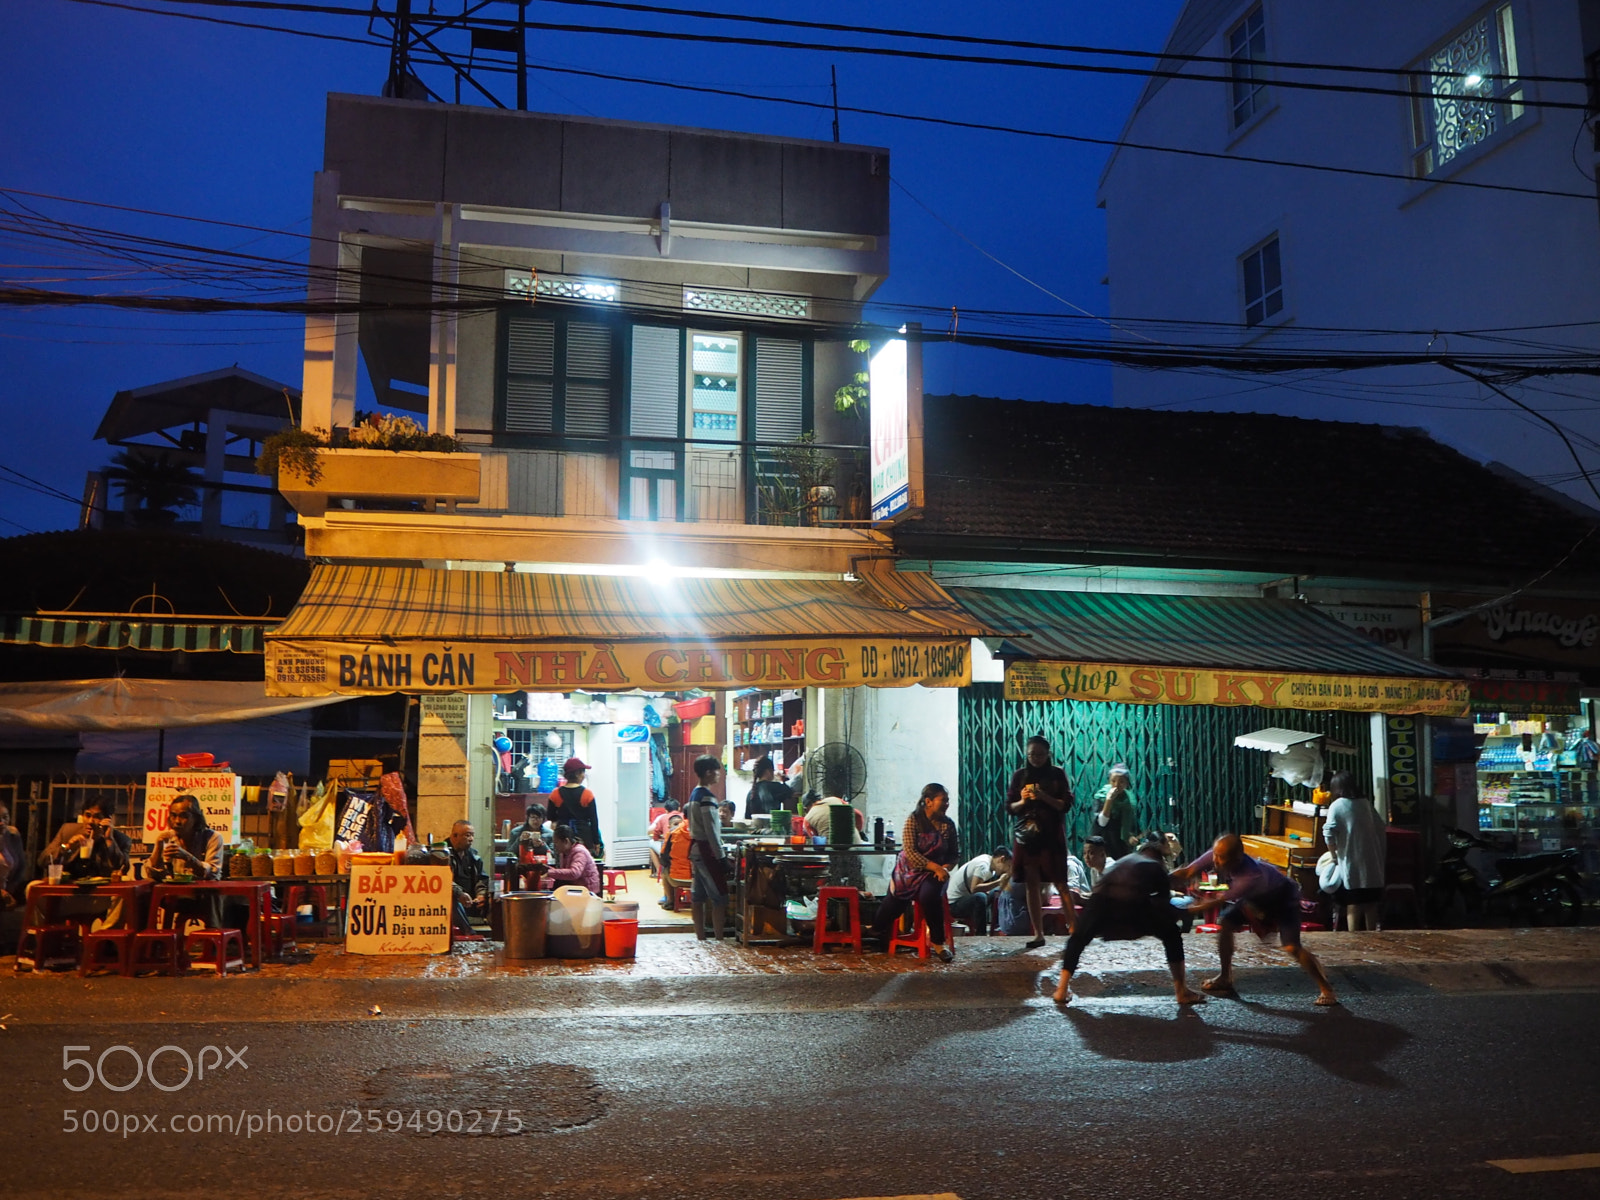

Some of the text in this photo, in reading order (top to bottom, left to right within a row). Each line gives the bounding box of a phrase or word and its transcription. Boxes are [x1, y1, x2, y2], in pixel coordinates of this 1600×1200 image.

[1353, 612, 1392, 622] LINH
[339, 645, 411, 687] BÁNH
[422, 646, 474, 686] CĂN
[494, 641, 630, 685] NHÀ
[645, 648, 850, 683] CHUNG
[892, 645, 964, 677] 0912.189648
[1056, 665, 1289, 706] Shop SU KY
[150, 775, 174, 788] BÁNH
[177, 775, 206, 788] TRÁNG
[206, 807, 230, 815] Xanh
[349, 796, 374, 815] MY
[344, 808, 367, 825] BIG
[337, 826, 360, 840] BAG
[341, 818, 363, 834] BLUE
[358, 867, 442, 894] BẮP XÀO
[350, 898, 387, 936] SỮA
[393, 905, 447, 920] Đậu nành
[392, 923, 446, 938] Đậu xanh
